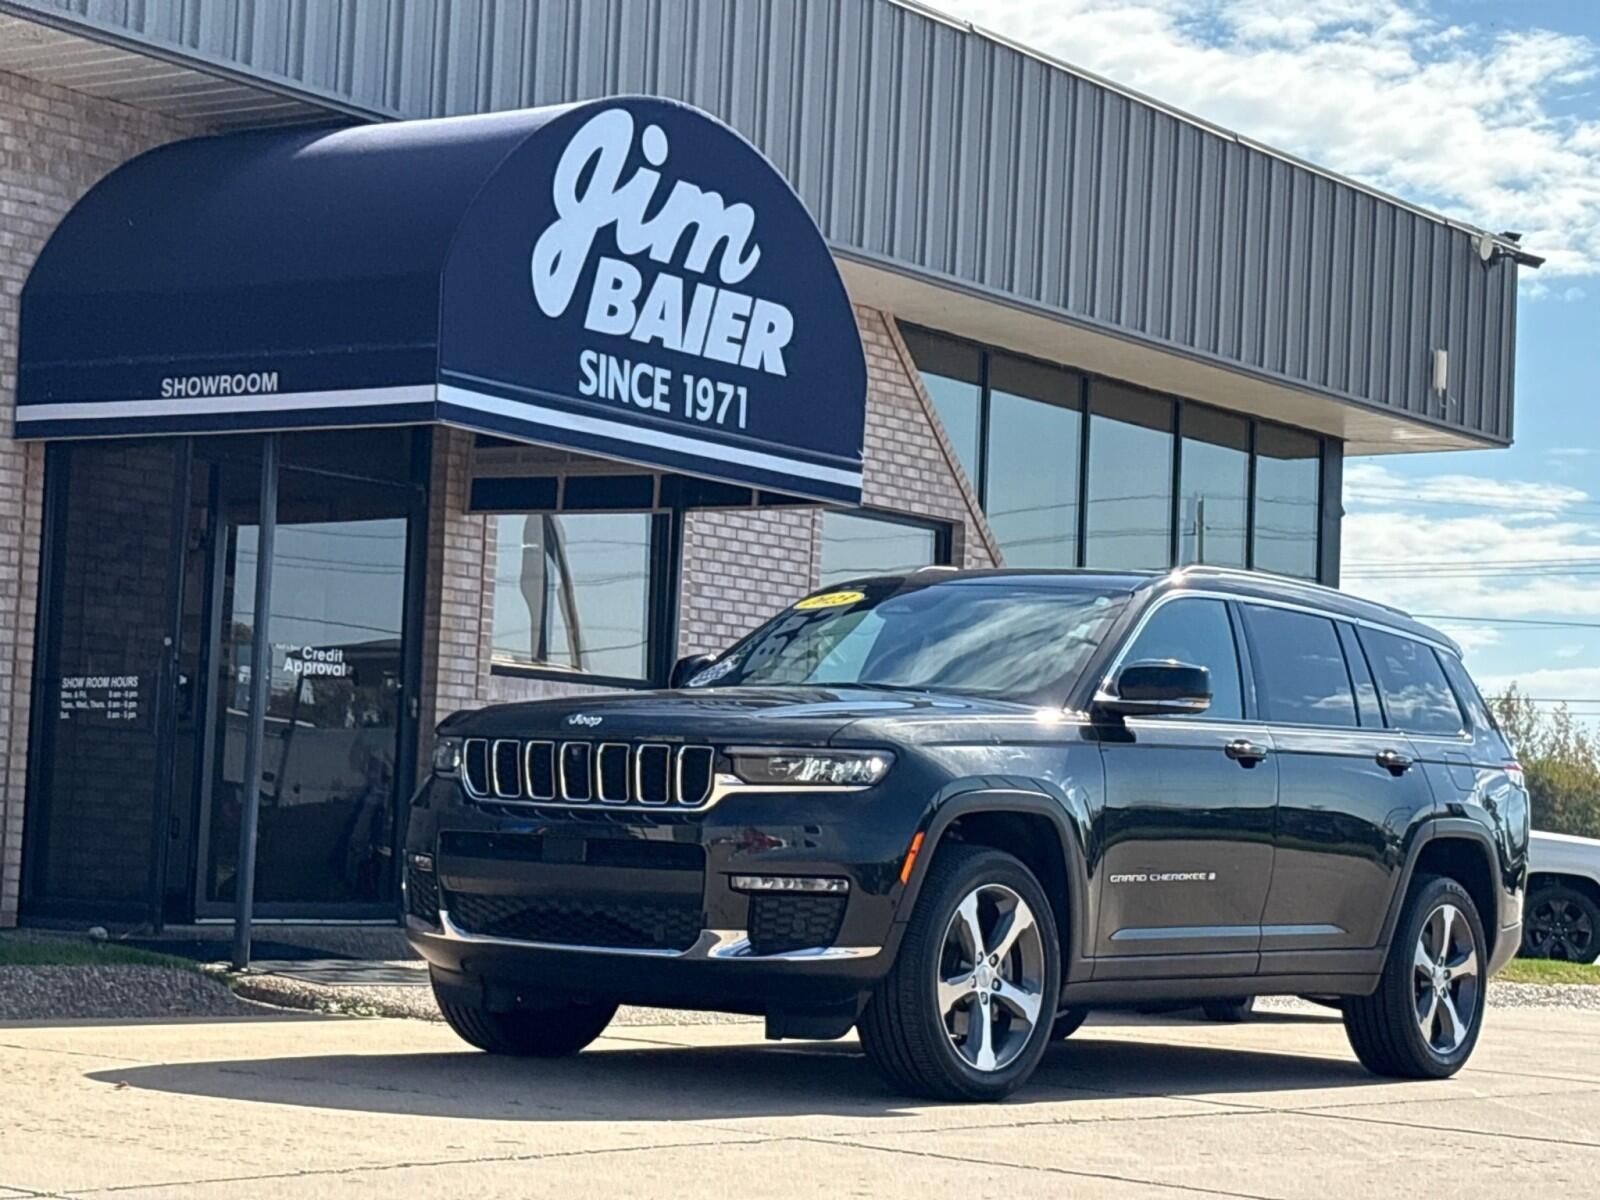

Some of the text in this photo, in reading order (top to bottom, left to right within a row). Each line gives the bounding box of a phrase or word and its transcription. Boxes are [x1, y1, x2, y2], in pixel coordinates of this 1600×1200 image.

[531, 108, 761, 318] Jim
[584, 256, 794, 377] BAIER
[161, 372, 278, 398] SHOWROOM
[578, 350, 748, 429] SINCE 1971
[302, 646, 343, 662] Credit
[62, 676, 138, 689] SHOW ROOM HOURS
[569, 714, 603, 728] Jeep
[1110, 874, 1147, 883] GRAND
[1149, 872, 1207, 881] CHEROKEE
